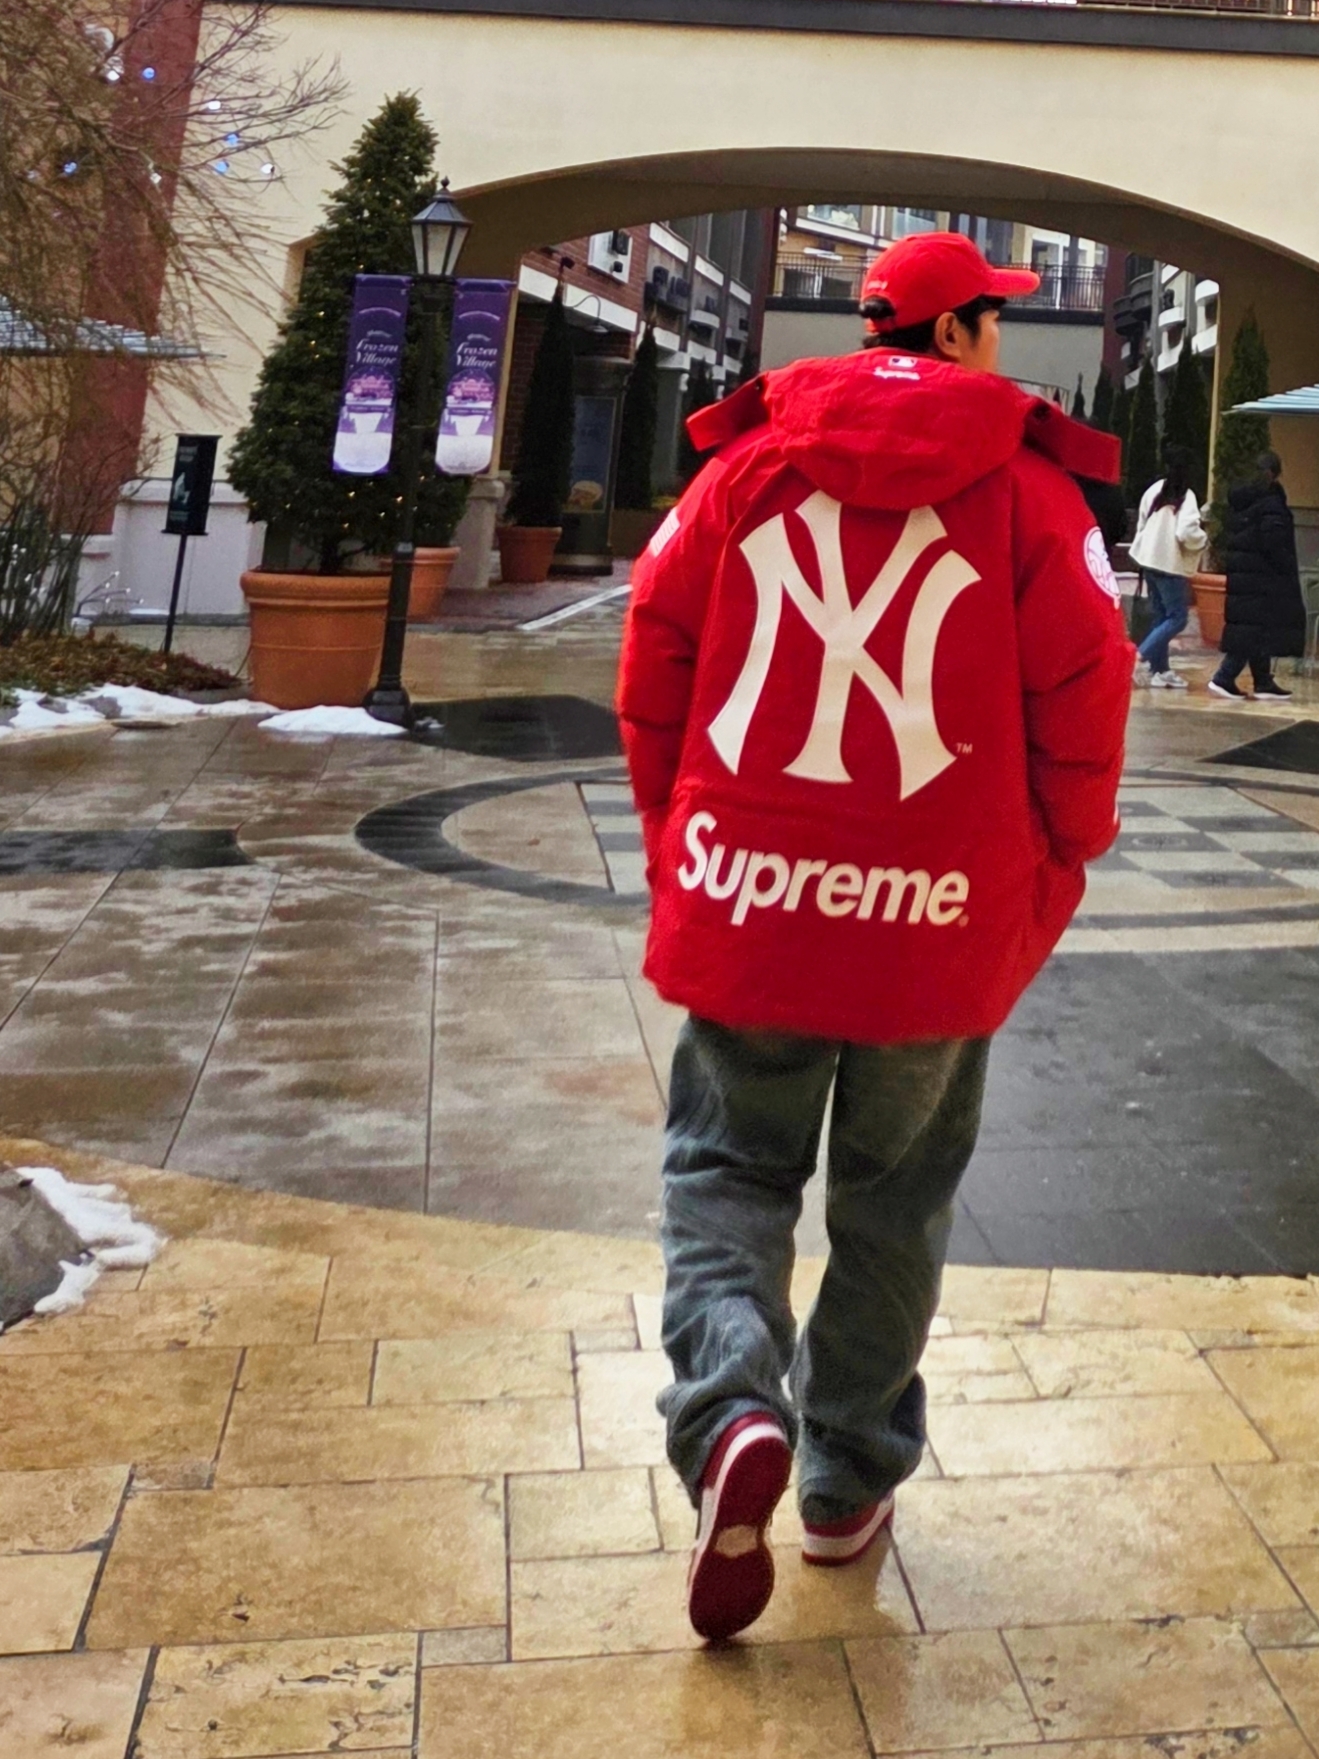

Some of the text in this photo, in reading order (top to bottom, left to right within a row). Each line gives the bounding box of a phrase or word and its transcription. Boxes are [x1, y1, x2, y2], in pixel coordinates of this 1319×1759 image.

[356, 338, 399, 352] Frozen
[456, 342, 498, 356] Frozen
[356, 351, 397, 366] Village
[456, 355, 497, 370] Village
[678, 809, 970, 925] Supreme
